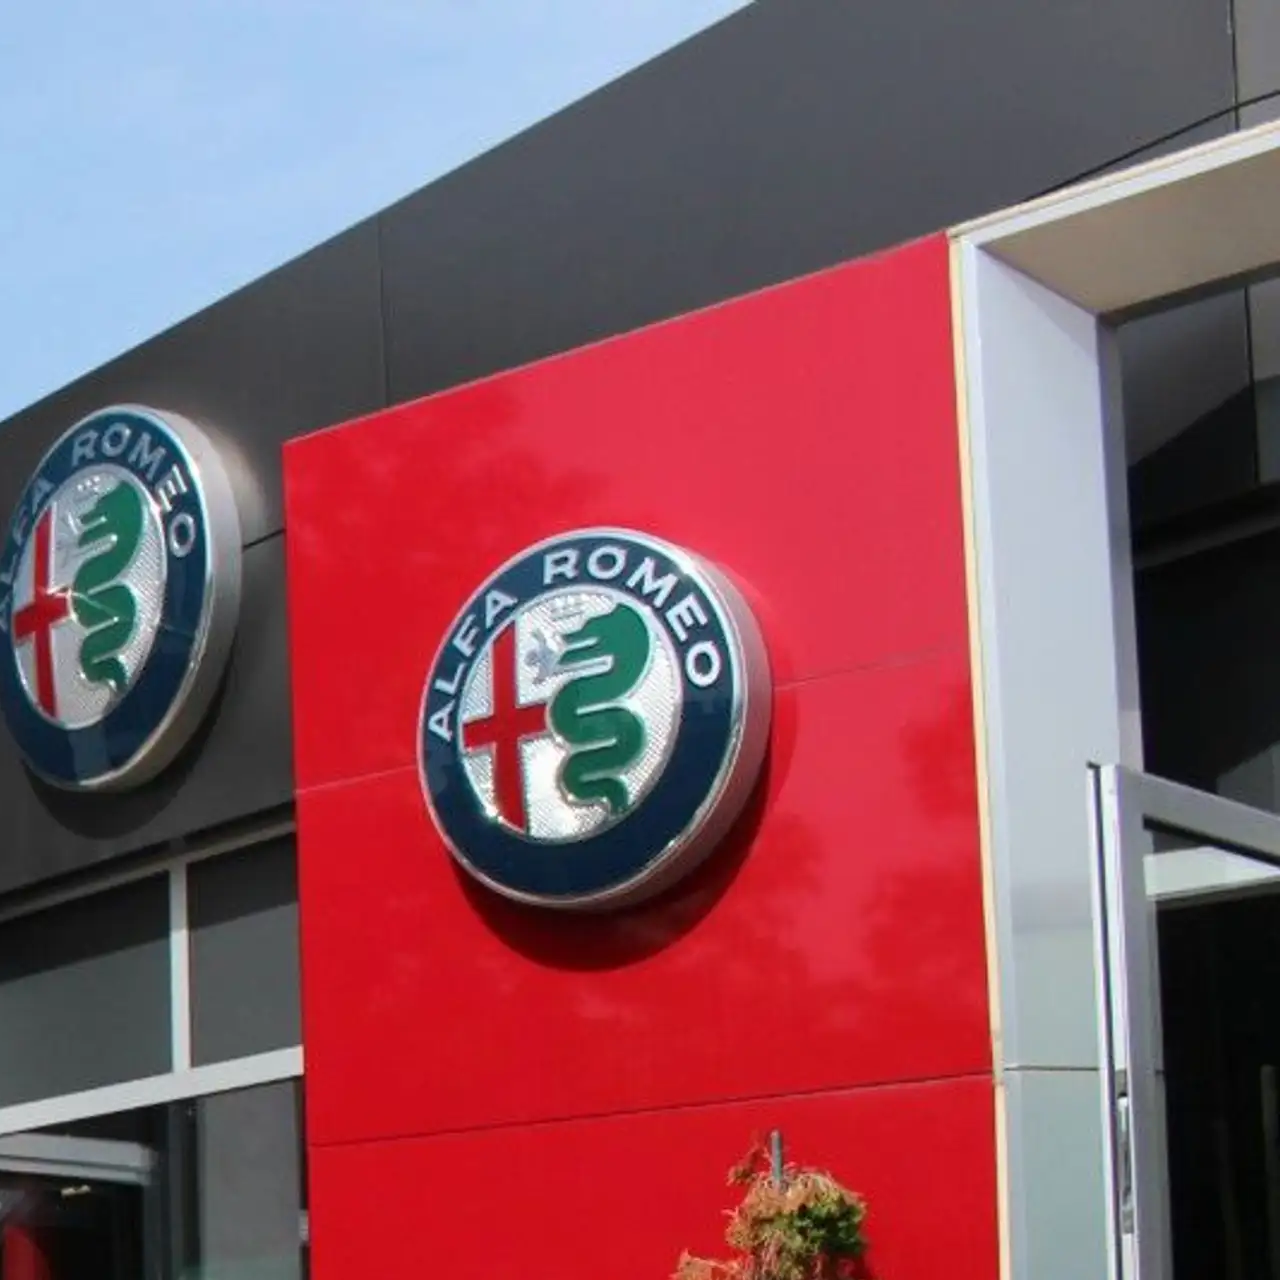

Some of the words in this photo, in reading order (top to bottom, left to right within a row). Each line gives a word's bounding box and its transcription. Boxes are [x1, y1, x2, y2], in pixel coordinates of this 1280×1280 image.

[71, 422, 196, 557] ROMEO
[428, 589, 519, 743] ALFA
[543, 545, 721, 687] ROMEO
